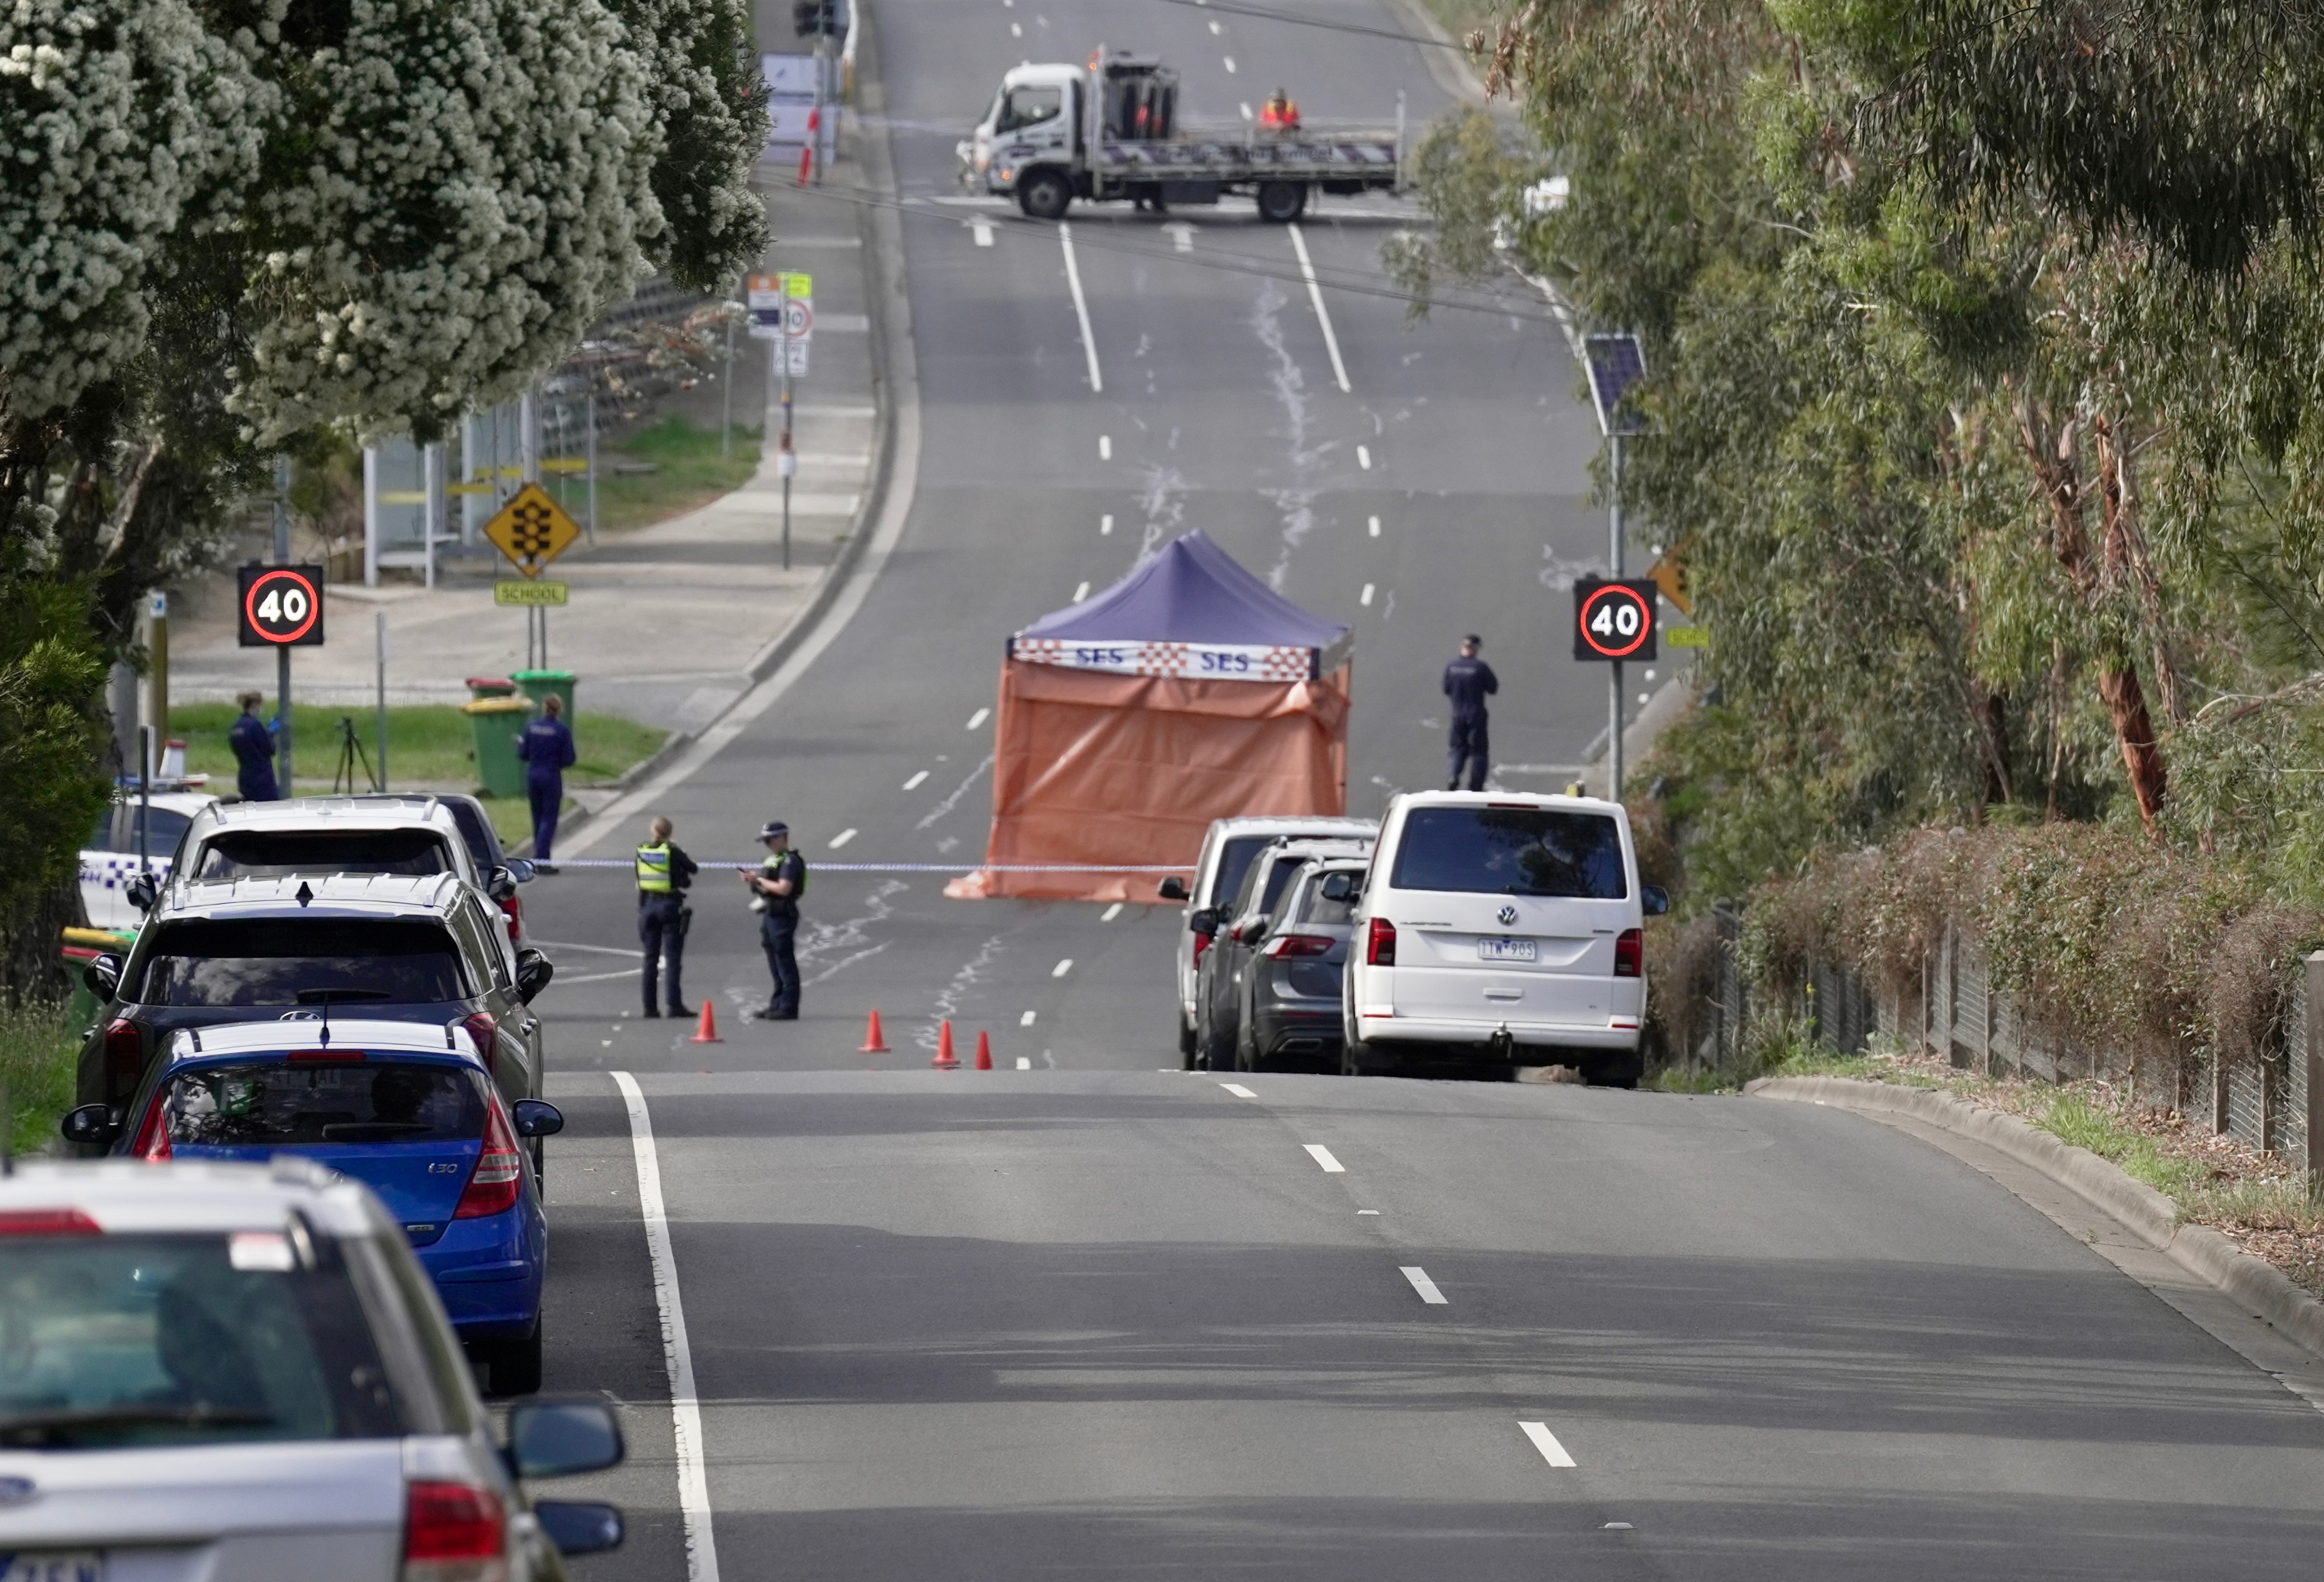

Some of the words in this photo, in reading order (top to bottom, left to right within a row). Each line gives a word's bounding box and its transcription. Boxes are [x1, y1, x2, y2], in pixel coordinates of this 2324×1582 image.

[501, 587, 561, 601] SCHOOL
[258, 589, 307, 622] 40
[1591, 604, 1638, 636] 40
[1075, 648, 1123, 664] SES
[1201, 652, 1249, 671] SES
[428, 1163, 458, 1174] i30
